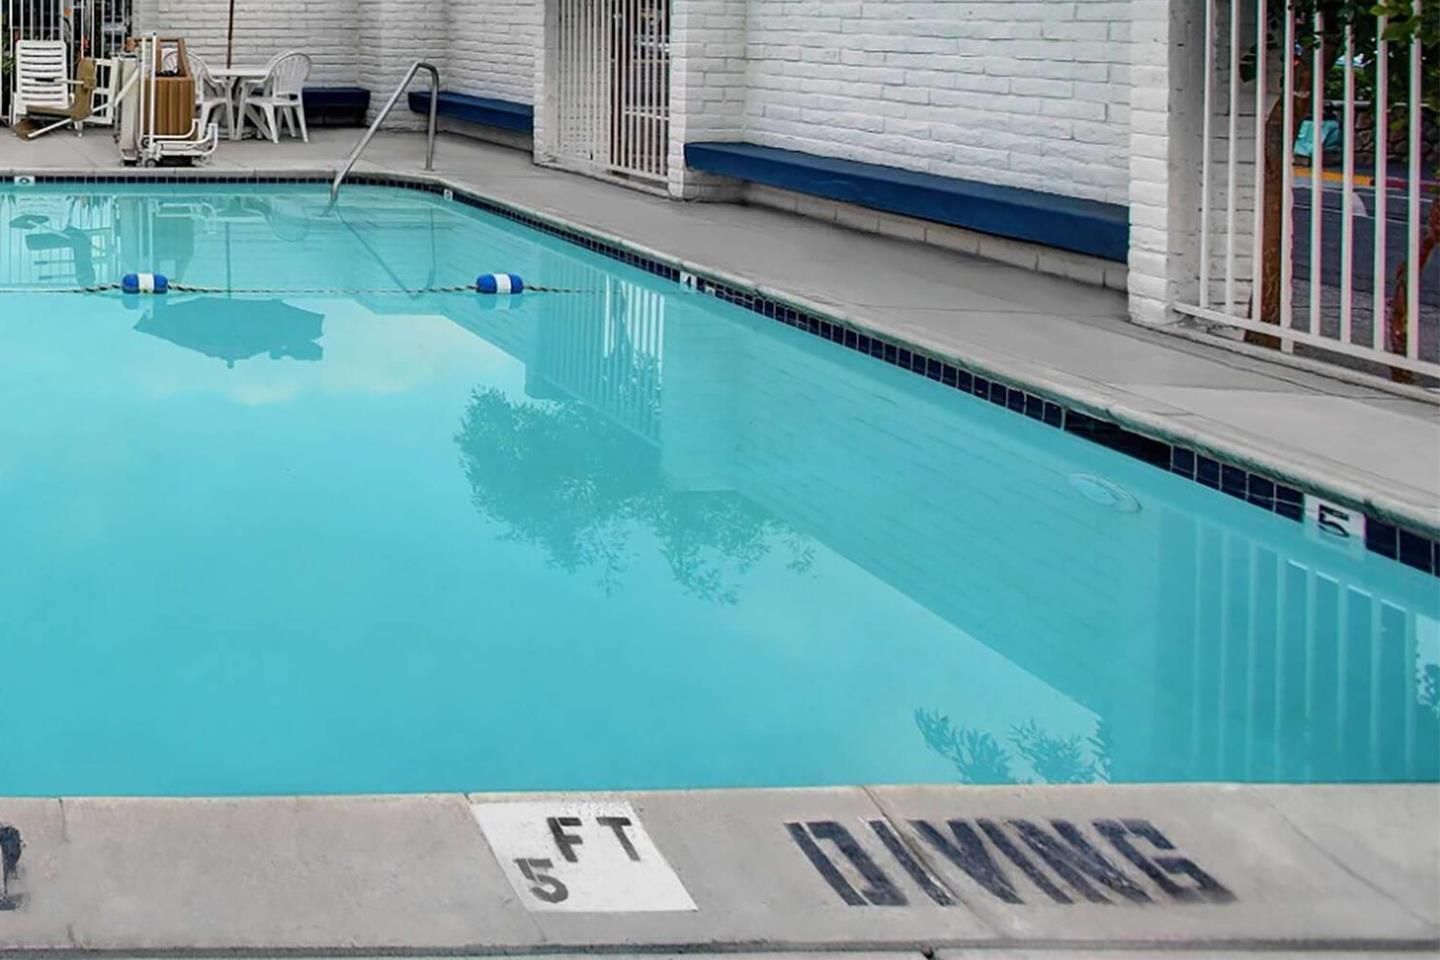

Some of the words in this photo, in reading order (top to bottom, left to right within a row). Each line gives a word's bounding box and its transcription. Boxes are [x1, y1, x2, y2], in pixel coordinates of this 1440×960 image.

[1318, 503, 1350, 538] 5
[546, 816, 641, 863] FT
[783, 818, 1238, 907] DIVING
[513, 858, 569, 904] 5
